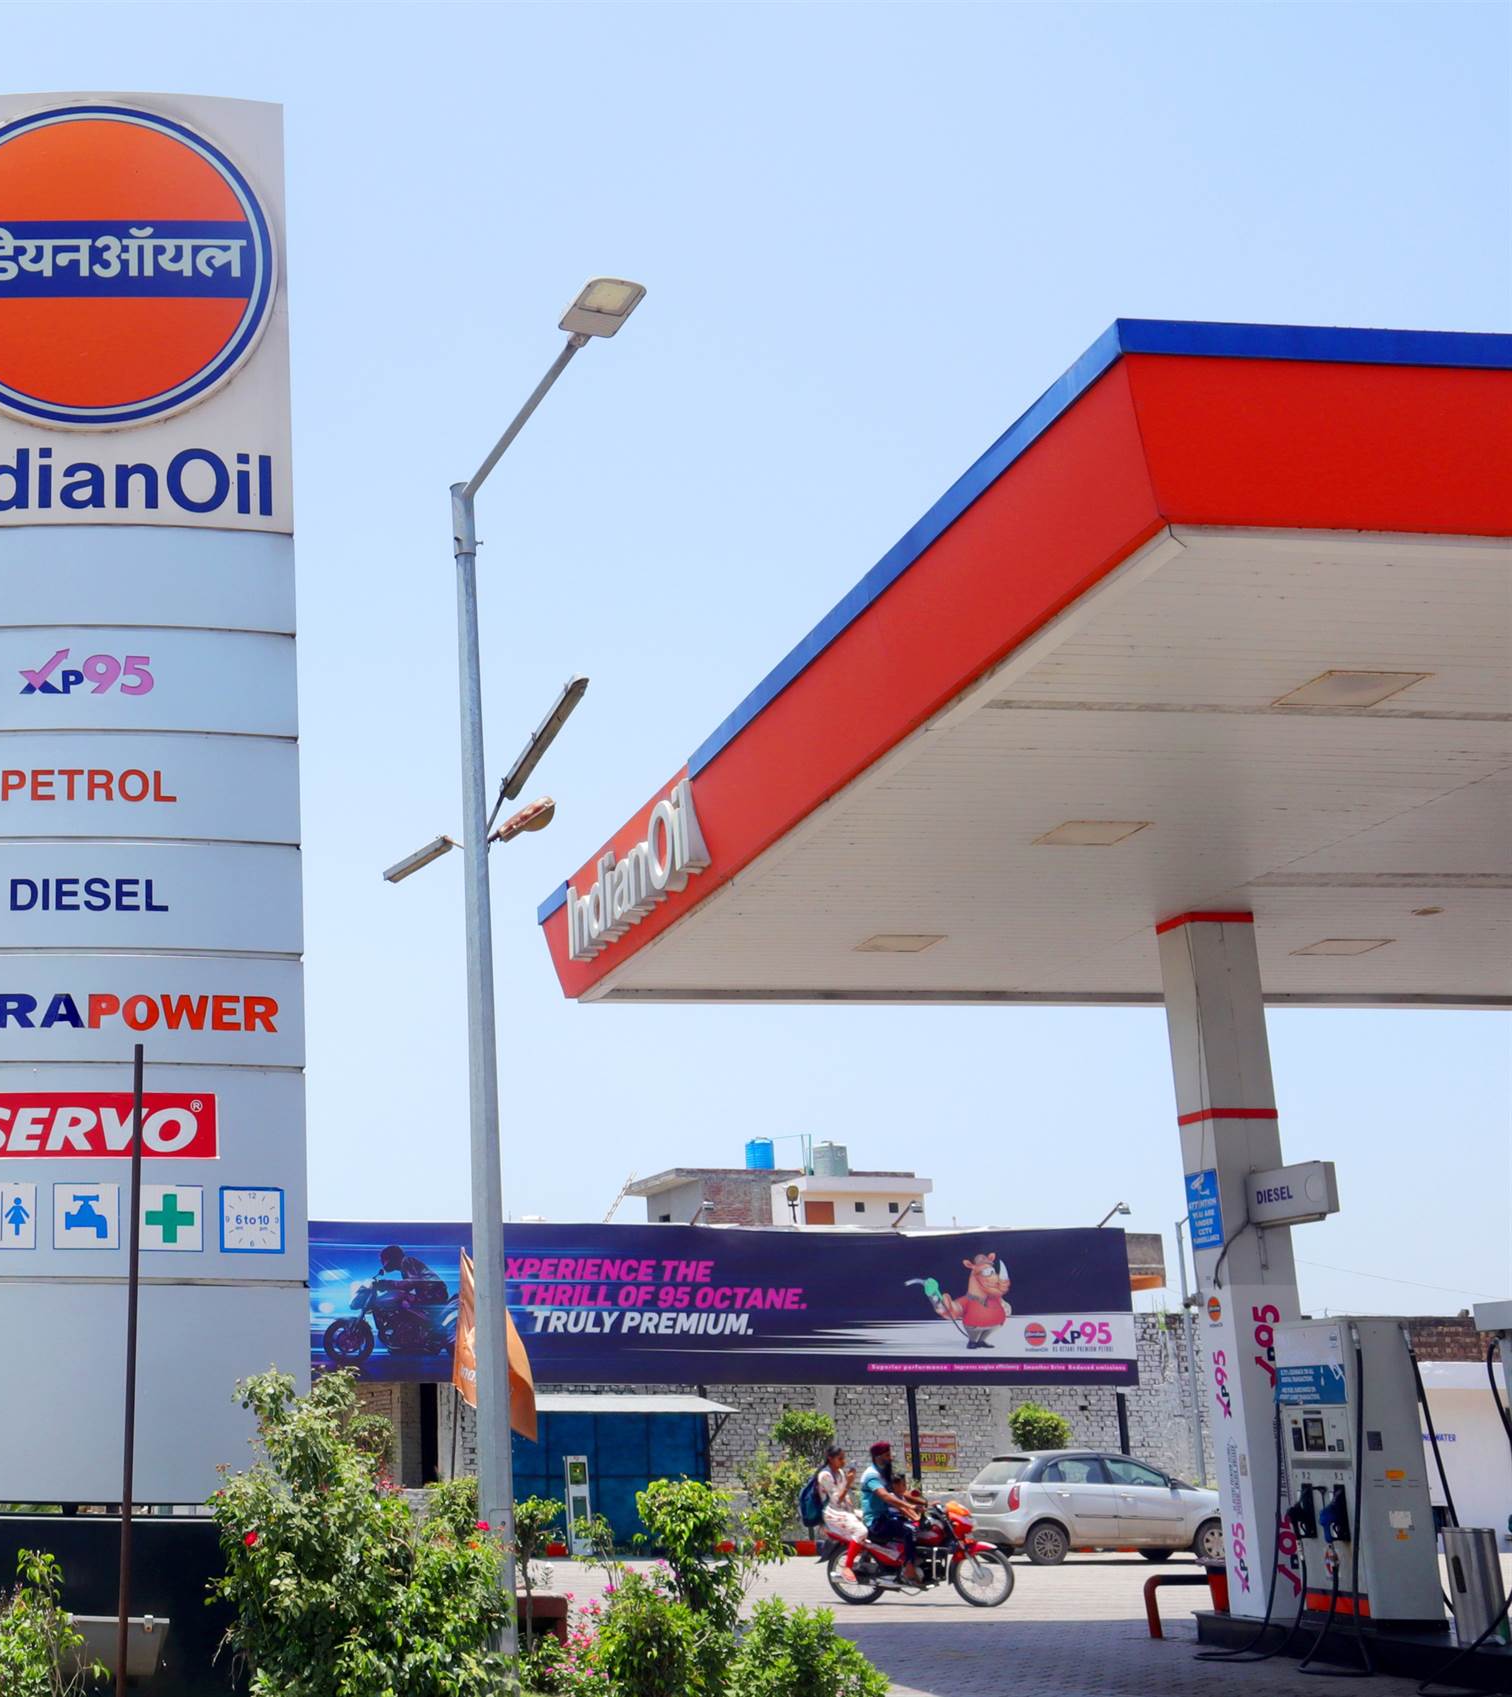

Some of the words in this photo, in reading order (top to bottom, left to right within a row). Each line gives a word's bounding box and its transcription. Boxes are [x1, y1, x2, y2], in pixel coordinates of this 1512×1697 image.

[18, 648, 154, 696] XP95
[1, 769, 177, 802] PETROL
[567, 777, 711, 962] IndianOil
[9, 877, 169, 912] DIESEL
[1256, 1185, 1294, 1205] DIESEL
[235, 1214, 243, 1225] 6
[244, 1215, 257, 1225] to
[258, 1215, 270, 1225] 10
[661, 1260, 715, 1283] THE
[520, 1284, 615, 1308] THRILL
[617, 1285, 658, 1308] OF
[657, 1286, 693, 1309] 95
[694, 1287, 808, 1310] OCTANE.
[532, 1310, 622, 1334] TRULY
[621, 1312, 755, 1335] PREMIUM.
[1051, 1320, 1113, 1345] XP95
[1212, 1350, 1232, 1419] XP95
[1232, 1522, 1250, 1594] XP95
